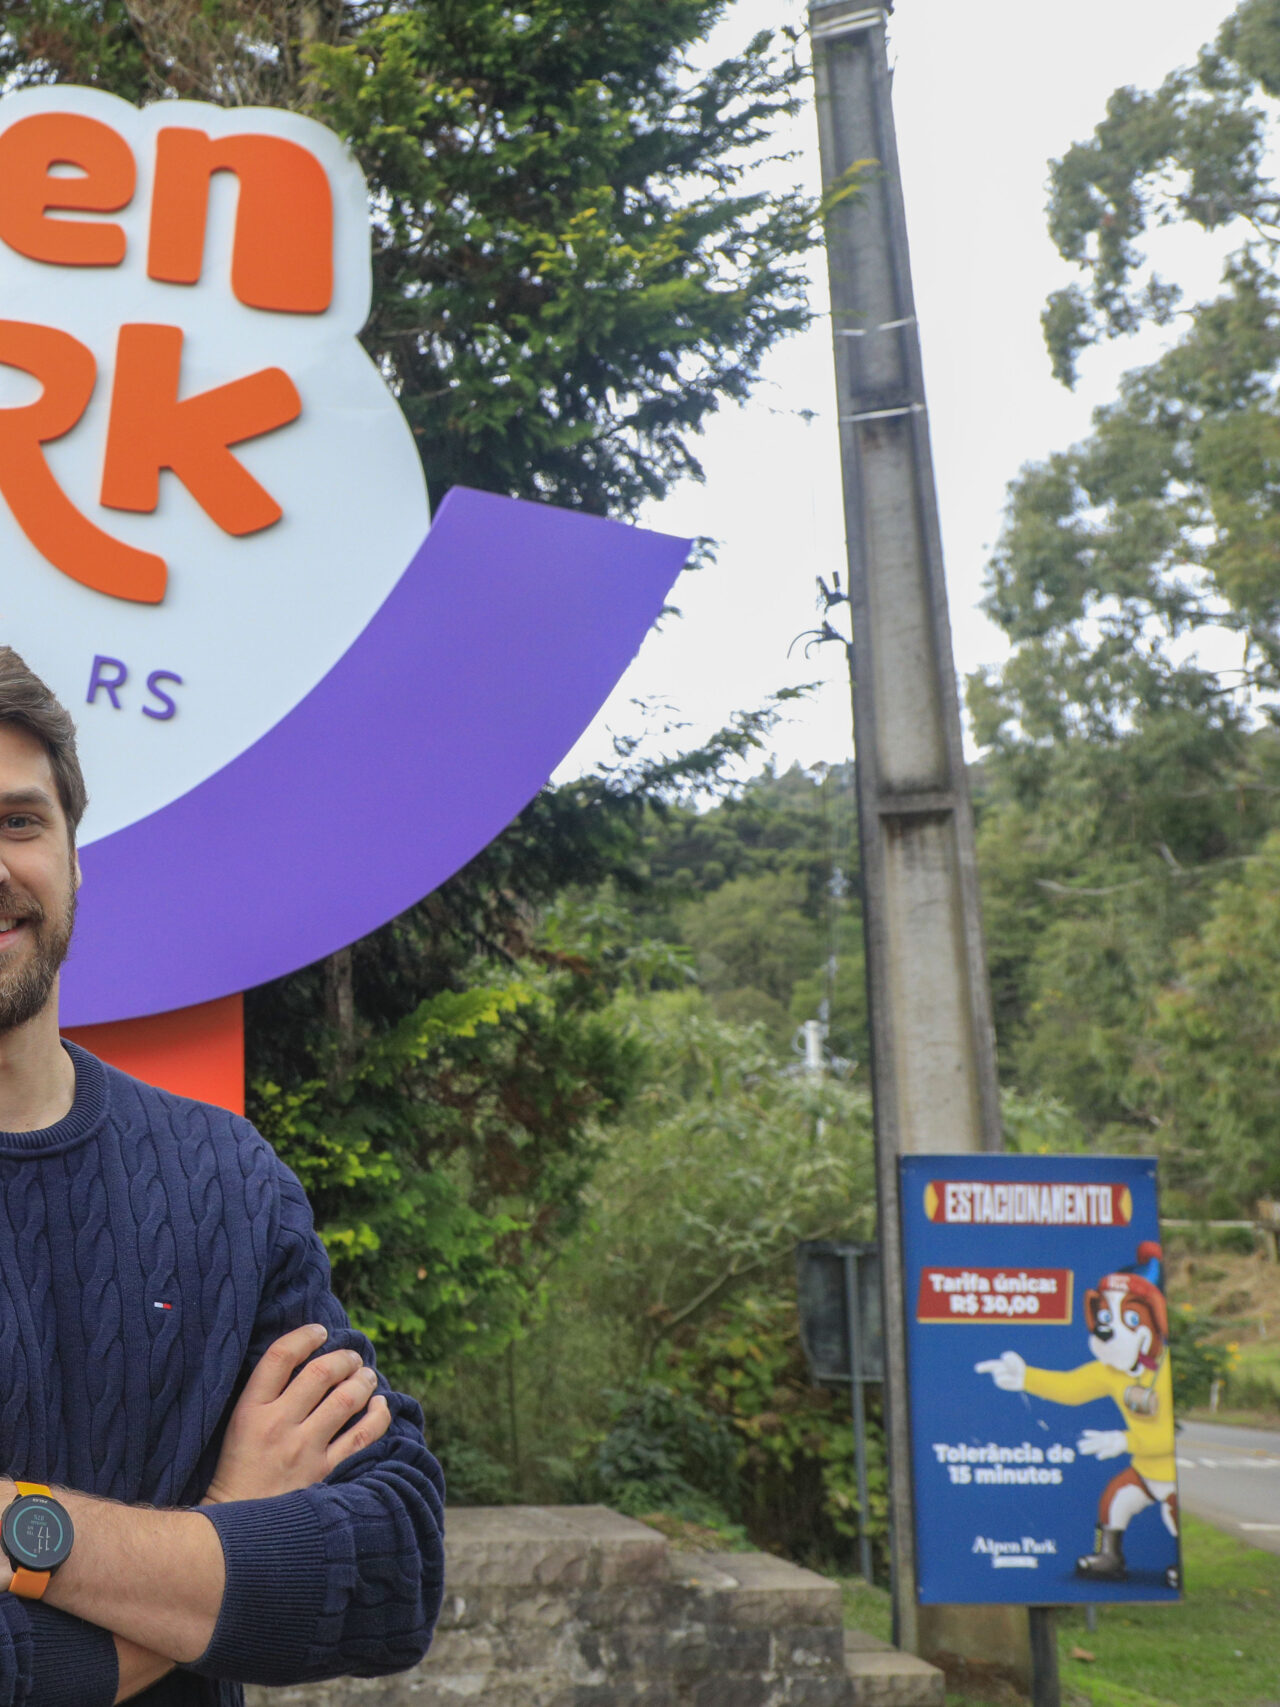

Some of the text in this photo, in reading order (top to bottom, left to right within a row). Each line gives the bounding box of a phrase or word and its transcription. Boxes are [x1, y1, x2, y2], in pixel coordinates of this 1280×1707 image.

[86, 655, 183, 720] RS
[945, 1182, 1113, 1224] ESTACIONAMENTO
[929, 1271, 1057, 1293] Tarifa única:
[949, 1293, 1039, 1316] R$ 30,00
[932, 1442, 1075, 1463] Tolerância de
[947, 1463, 1063, 1484] 15 minutos
[971, 1535, 1057, 1556] Alpen Park
